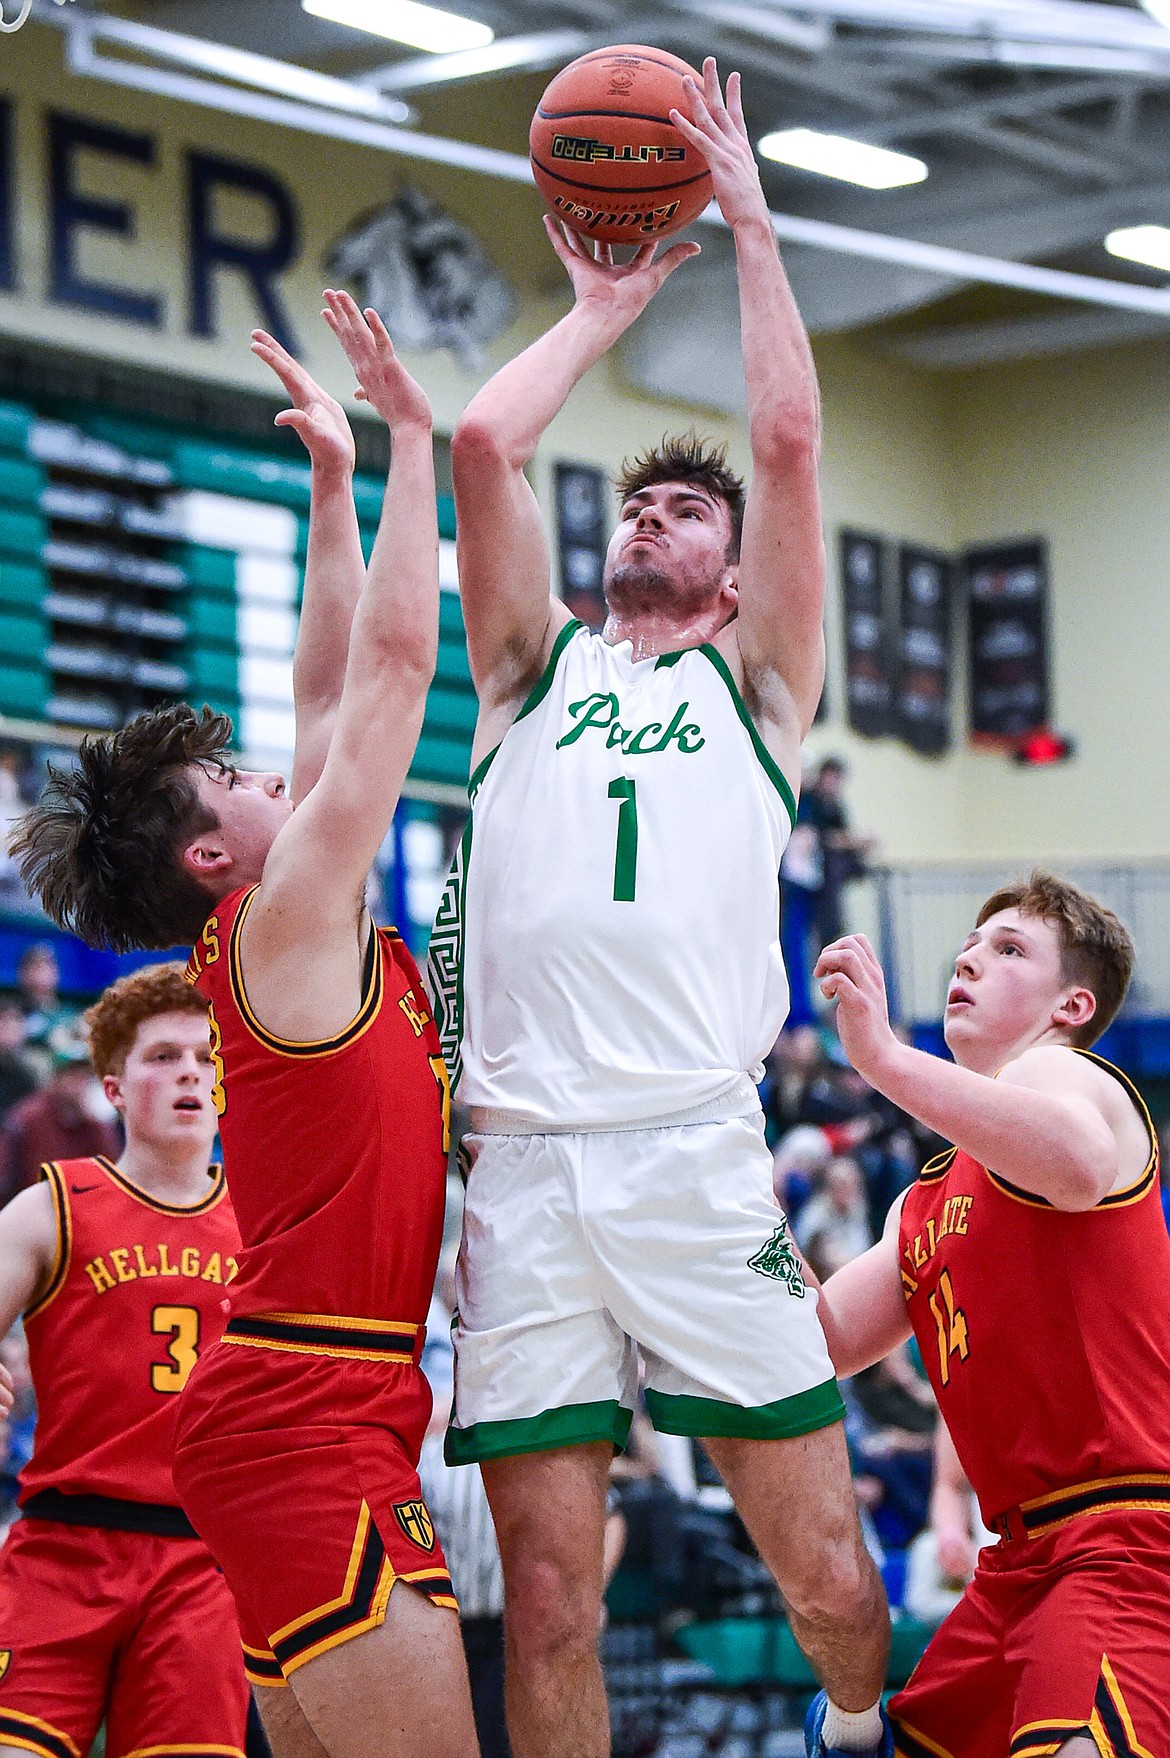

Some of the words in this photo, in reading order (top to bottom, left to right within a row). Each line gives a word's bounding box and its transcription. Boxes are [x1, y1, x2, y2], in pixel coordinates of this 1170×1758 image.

[553, 138, 589, 160] PRO
[590, 144, 686, 164] ELITE
[0, 94, 302, 360] ER
[553, 195, 681, 233] Baden
[556, 691, 706, 755] Pack
[607, 776, 639, 903] 1
[149, 1303, 201, 1395] 3
[927, 1266, 972, 1389] 14
